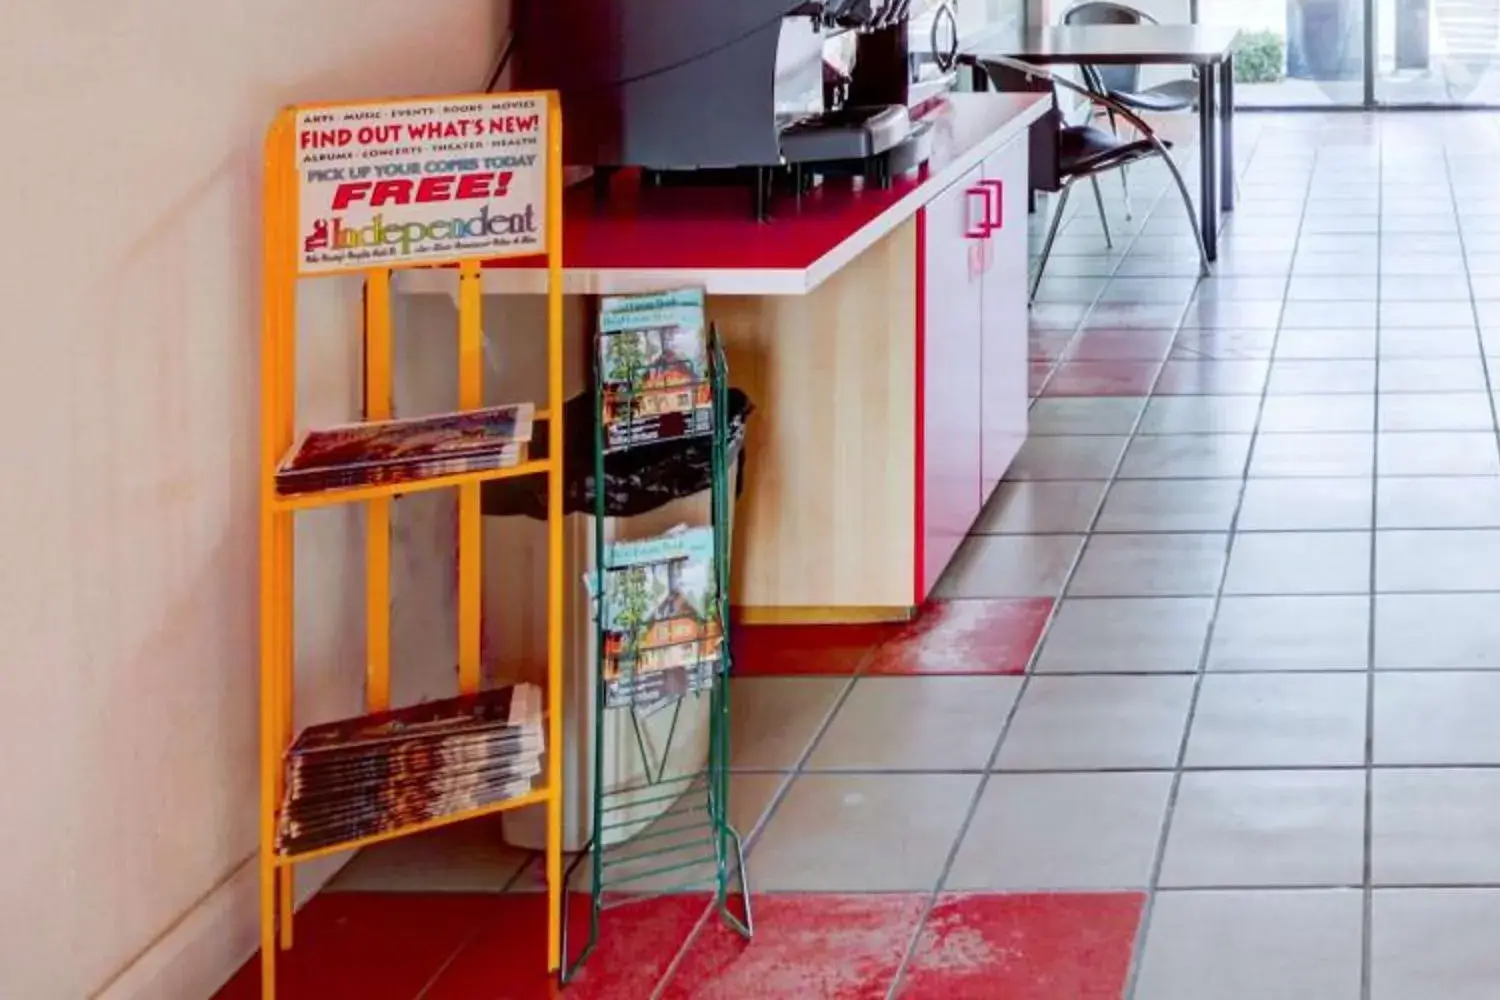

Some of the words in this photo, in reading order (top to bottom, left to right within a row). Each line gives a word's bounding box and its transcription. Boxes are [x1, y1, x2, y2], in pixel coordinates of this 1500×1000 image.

[303, 114, 334, 123] ARTS
[343, 111, 381, 121] MUSIC
[391, 107, 434, 118] EVENTS
[443, 104, 483, 113] BOOKS
[491, 100, 536, 110] MOVIES
[300, 129, 353, 150] FIND
[358, 124, 402, 144] OUT
[408, 118, 484, 139] WHAT'S
[489, 114, 539, 134] NEW!
[303, 152, 353, 163] ALBUMS
[361, 146, 422, 159] CONCERTS
[432, 141, 483, 152] THEATER
[491, 137, 537, 147] HEALTH
[307, 168, 345, 184] PICK
[348, 165, 372, 180] UP
[375, 161, 421, 178] YOUR
[484, 153, 538, 170] TODAY
[331, 171, 513, 211] FREE!
[331, 203, 538, 255] Independent
